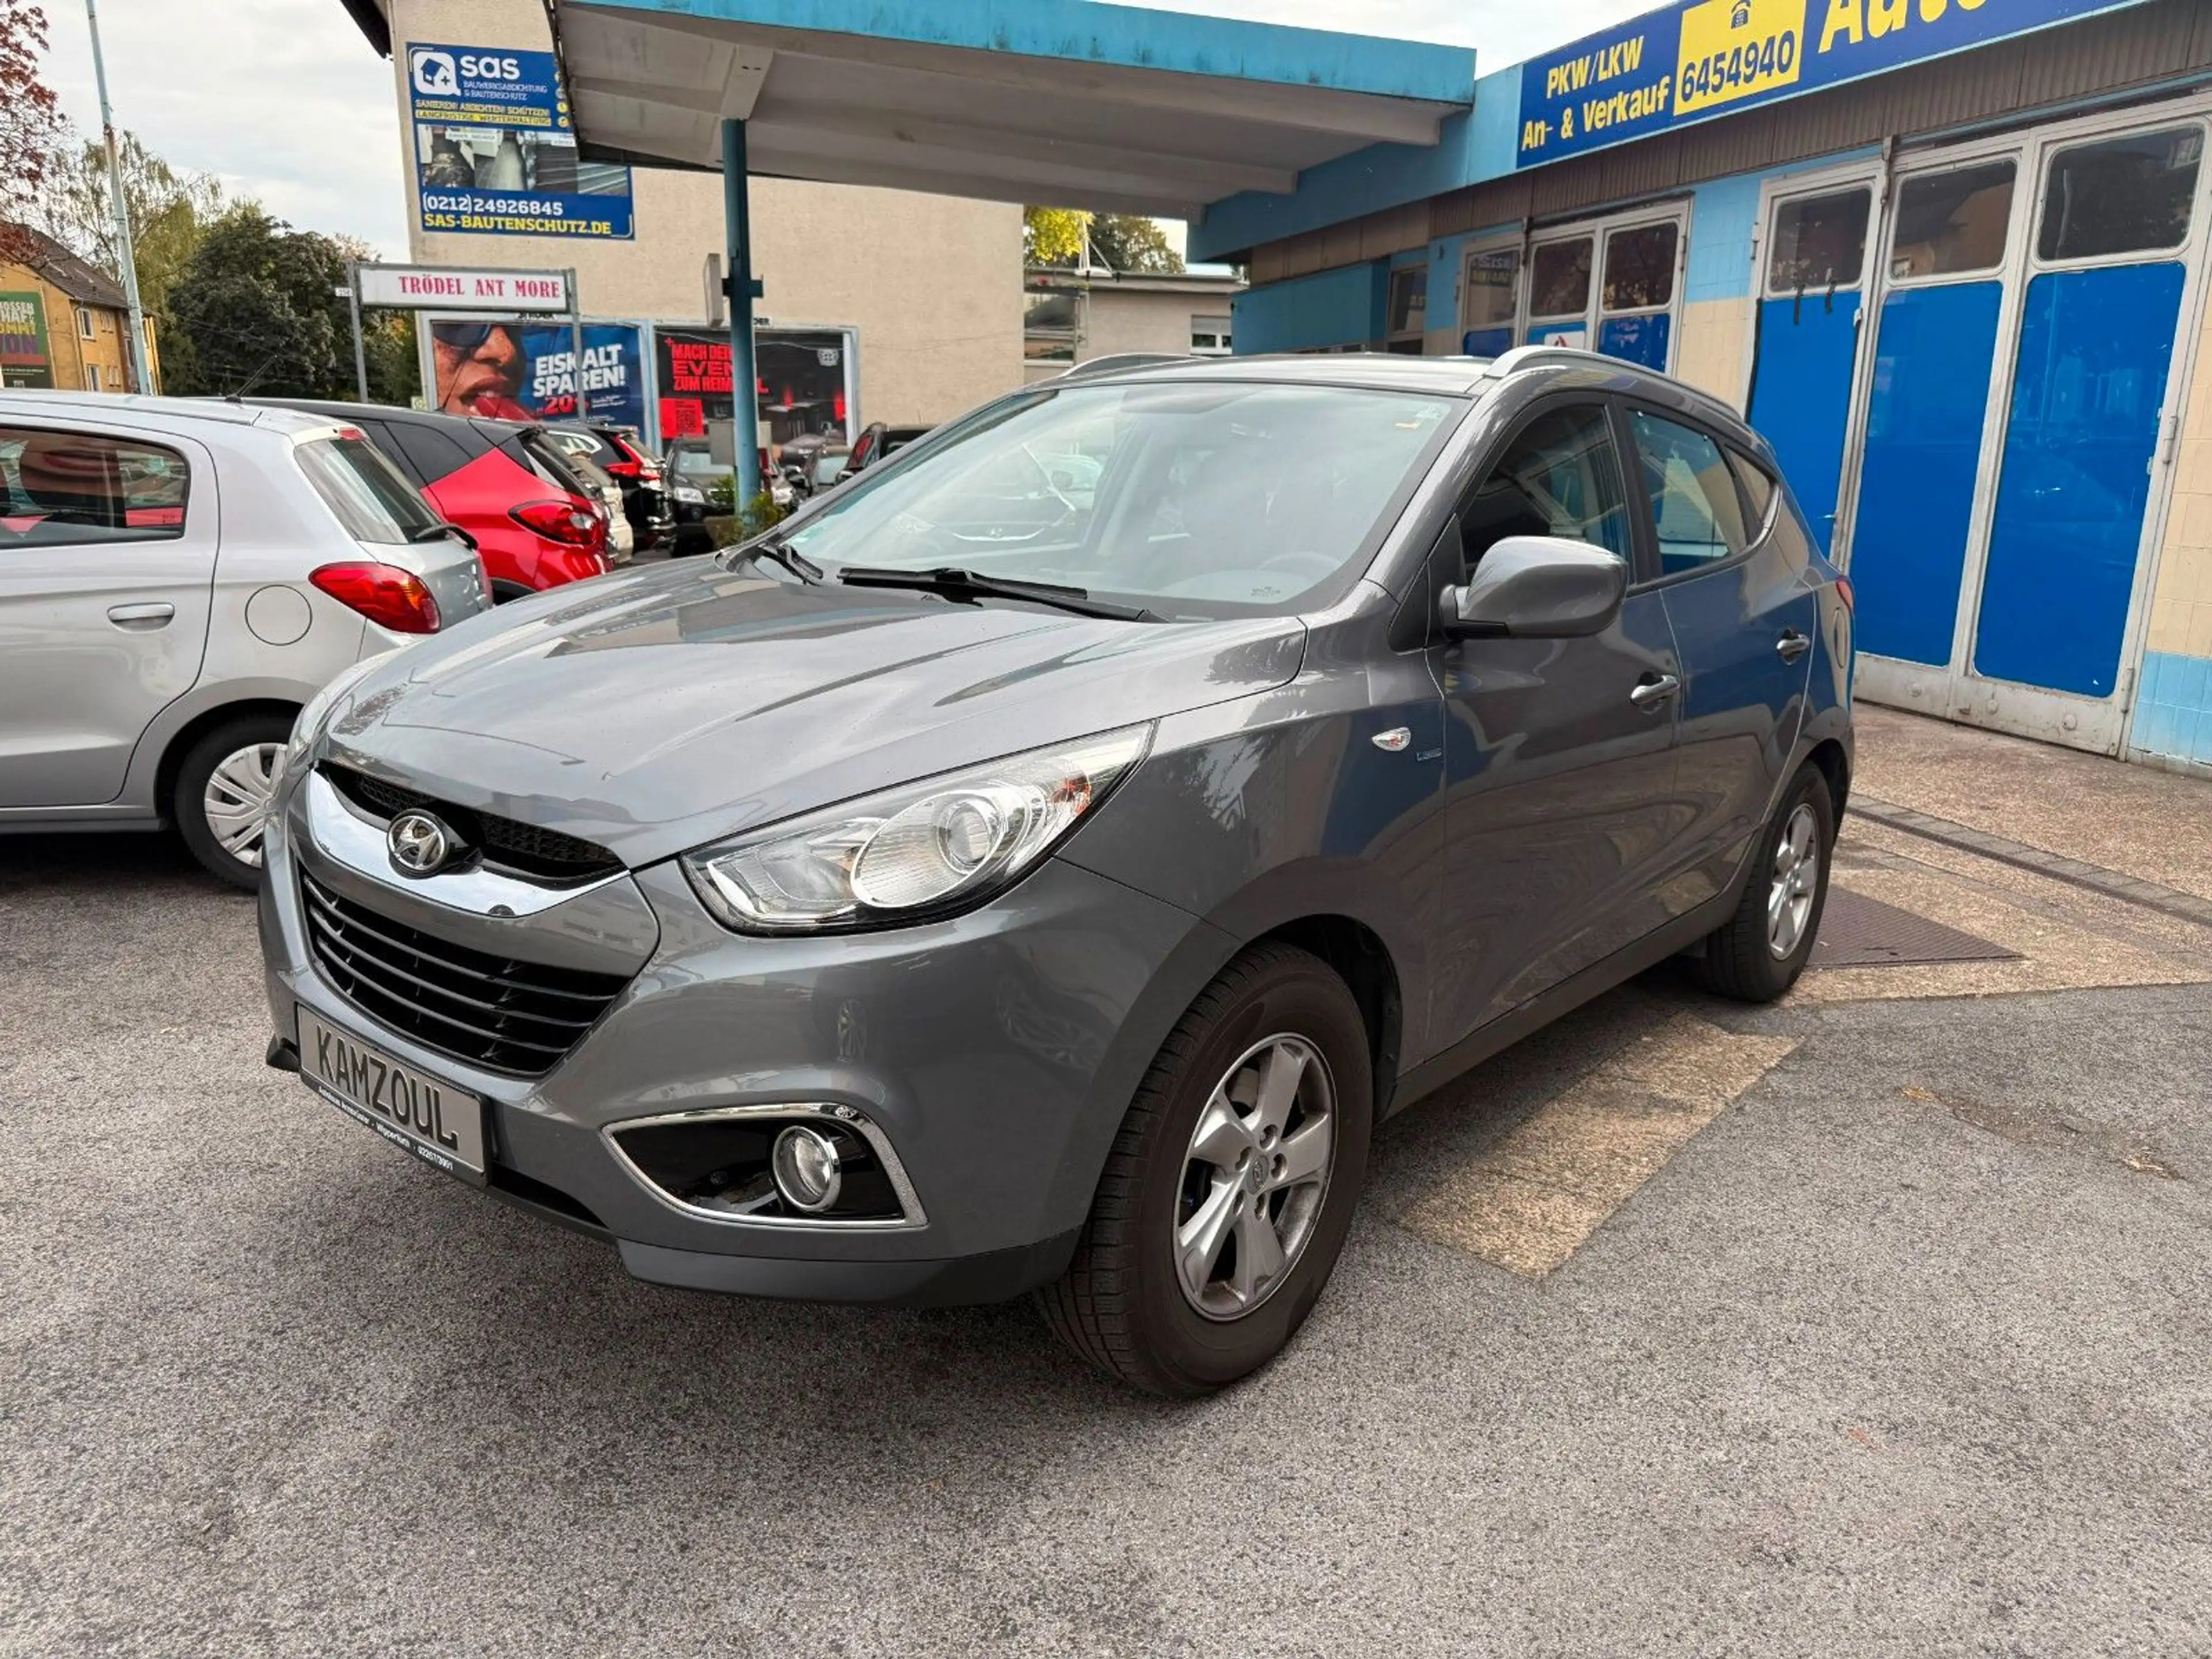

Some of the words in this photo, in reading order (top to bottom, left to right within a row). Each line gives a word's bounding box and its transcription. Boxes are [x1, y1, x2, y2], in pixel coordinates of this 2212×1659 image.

[1818, 0, 1986, 54] Au
[460, 55, 521, 80] sas
[1546, 35, 1645, 99] PKW/LKW
[1681, 31, 1795, 103] 6454940
[1521, 120, 1554, 151] An-
[1560, 107, 1574, 139] &
[1583, 75, 1671, 132] Verkauf
[422, 191, 564, 215] (0212)24926845
[424, 214, 612, 235] SAS-BAUTENSCHUTZ.DE
[398, 274, 465, 296] TRÖDEL
[475, 279, 505, 297] ANT
[515, 280, 560, 298] MORE
[536, 343, 623, 377] EISKALT
[672, 343, 707, 361] MACH
[533, 365, 626, 398] SPAREN!
[673, 376, 701, 391] ZUM
[316, 1024, 459, 1151] KAMZOUL
